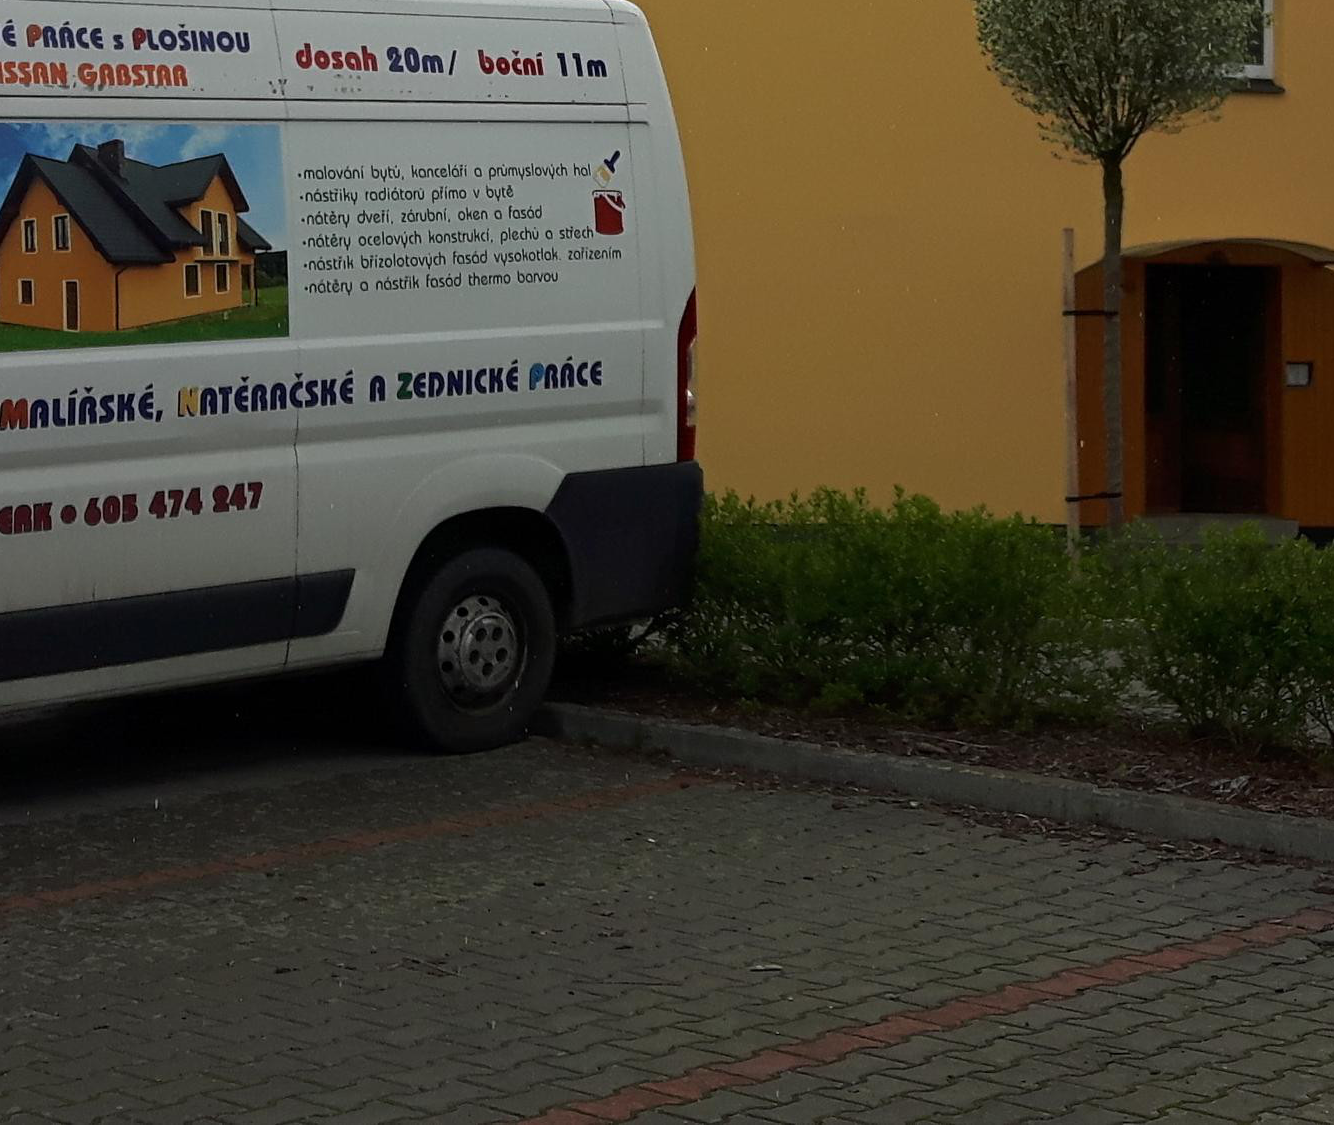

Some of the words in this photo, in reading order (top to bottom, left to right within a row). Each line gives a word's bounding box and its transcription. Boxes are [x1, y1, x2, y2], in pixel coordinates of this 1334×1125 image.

[26, 21, 103, 49] PRÁCE
[132, 24, 251, 53] PLOŠINOU
[296, 43, 379, 73] dosah
[387, 47, 457, 75] 20m/
[478, 49, 544, 76] boční
[557, 53, 607, 77] 11m
[77, 62, 188, 88] GABSTAR
[304, 166, 363, 180] malování
[411, 164, 467, 178] kanceláří
[474, 167, 482, 177] a
[489, 163, 568, 180] průmyslových
[574, 163, 591, 176] hal
[304, 188, 357, 205] nástřiky
[432, 186, 466, 204] přímo
[473, 189, 479, 198] v
[486, 185, 514, 202] bytě
[306, 211, 349, 228] nátěry
[458, 207, 488, 221] oken
[494, 210, 502, 220] a
[509, 205, 542, 219] fasád
[307, 234, 351, 251] nátěry
[358, 231, 421, 249] ocelových
[501, 227, 539, 245] plechů
[545, 230, 553, 240] a
[453, 250, 487, 264] fasád
[308, 279, 352, 296] nátěry
[360, 281, 368, 291] a
[376, 275, 419, 290] nástřik
[426, 272, 461, 288] fasád
[468, 272, 511, 286] thermo
[517, 271, 558, 283] barvou
[370, 375, 385, 402] A
[397, 359, 518, 400] ZEDNICKÉ
[529, 356, 603, 390] PRÁCE
[84, 494, 138, 526] 605
[149, 487, 203, 519] 474
[213, 482, 263, 513] 247
